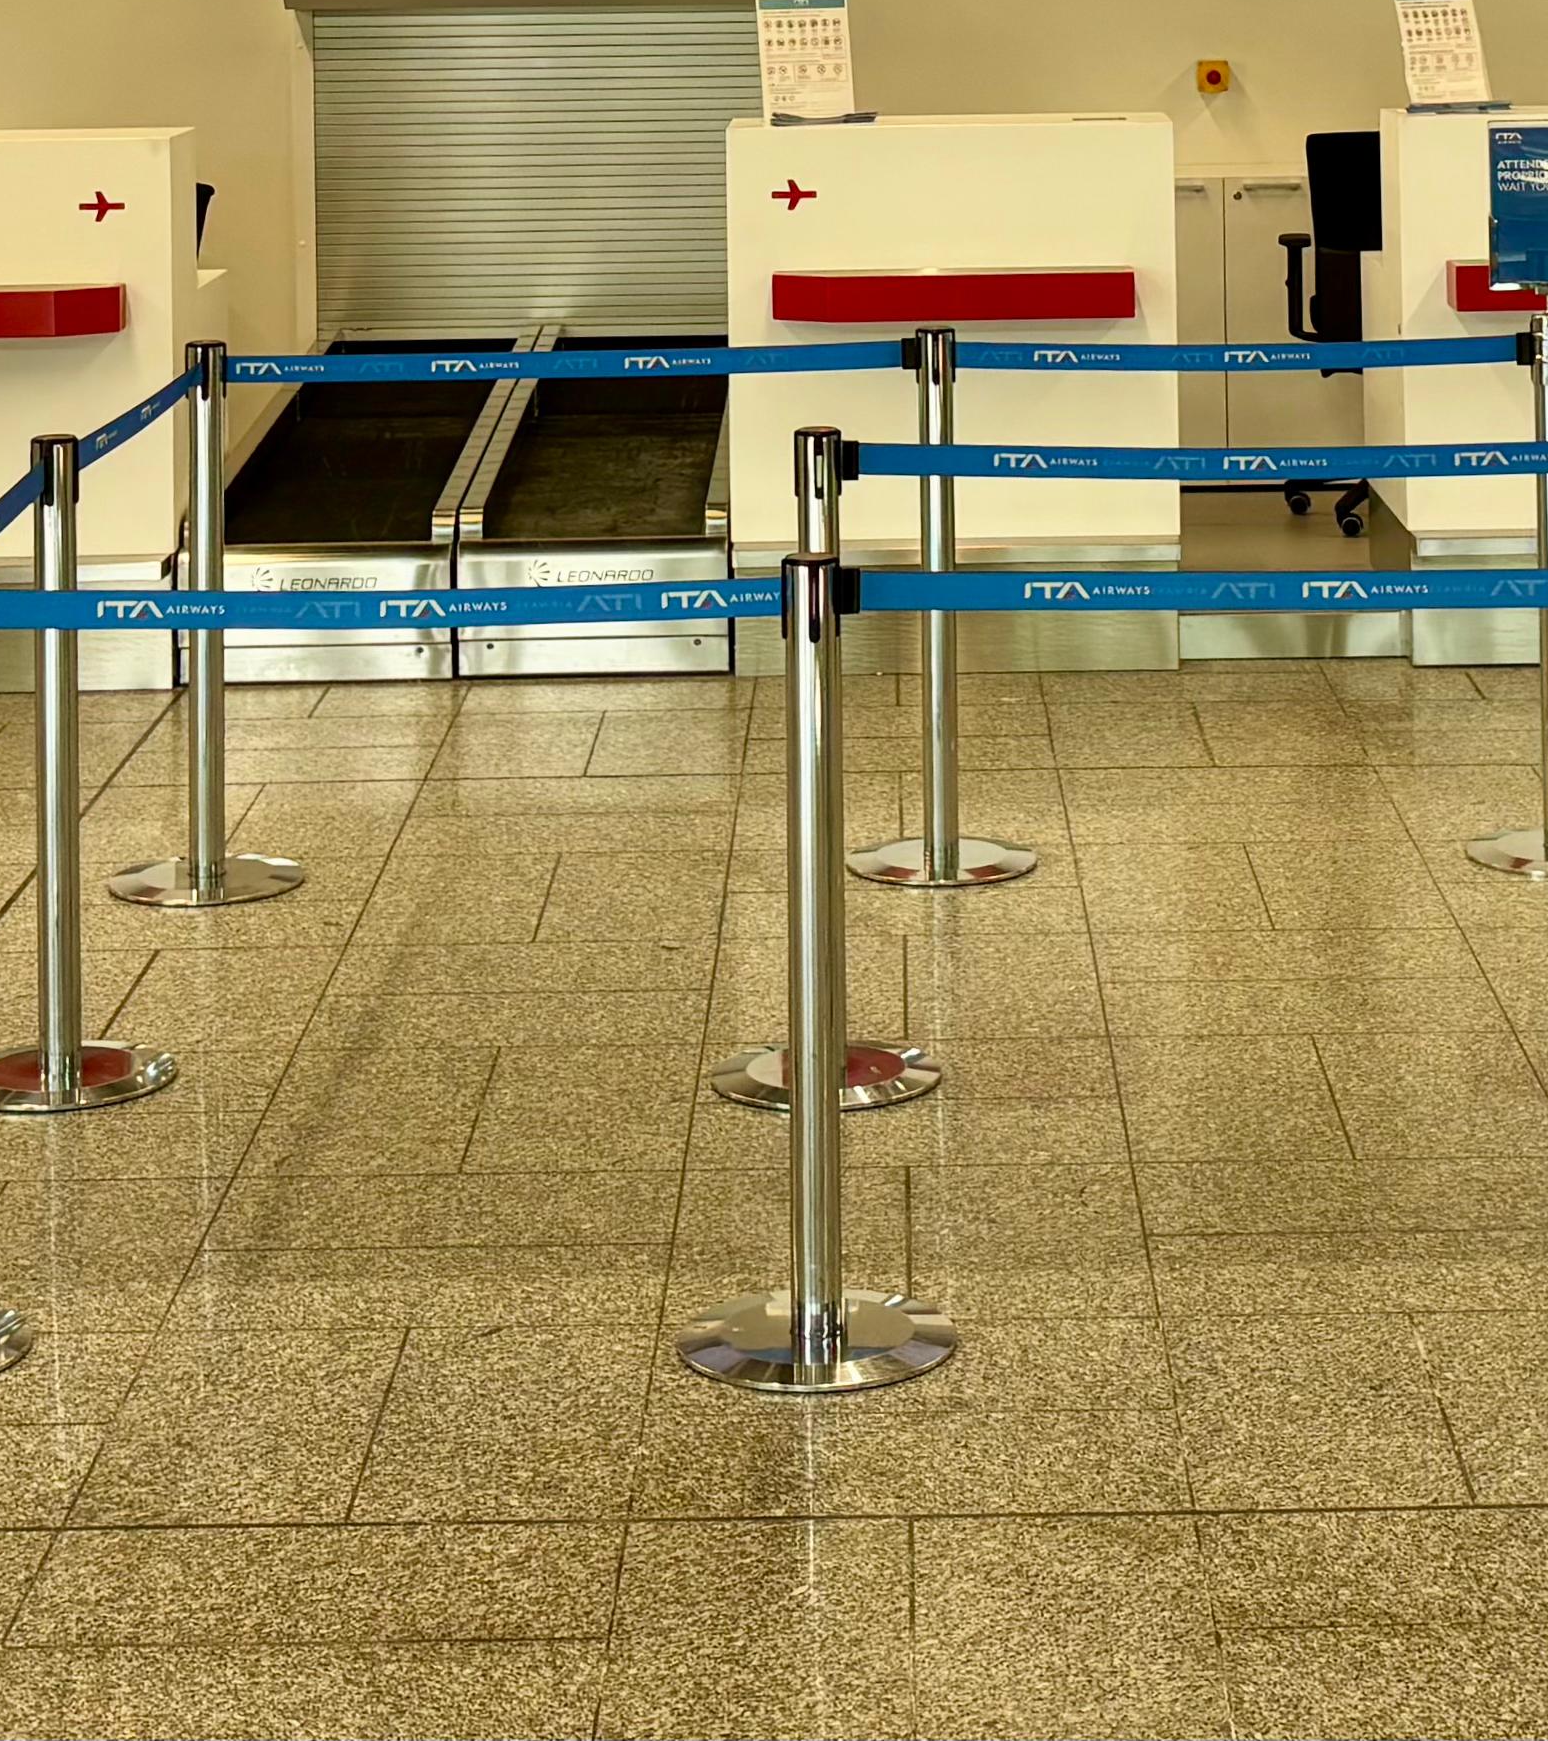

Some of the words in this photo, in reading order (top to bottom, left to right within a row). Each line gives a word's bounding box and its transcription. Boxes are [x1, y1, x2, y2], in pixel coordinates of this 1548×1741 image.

[1034, 350, 1079, 363] ITA
[1080, 353, 1120, 361] AIRWAYS
[1303, 581, 1367, 598] ITA
[1371, 585, 1429, 596] AIRWAYS
[97, 601, 163, 618] ITA
[166, 604, 225, 616] AIRWAYS
